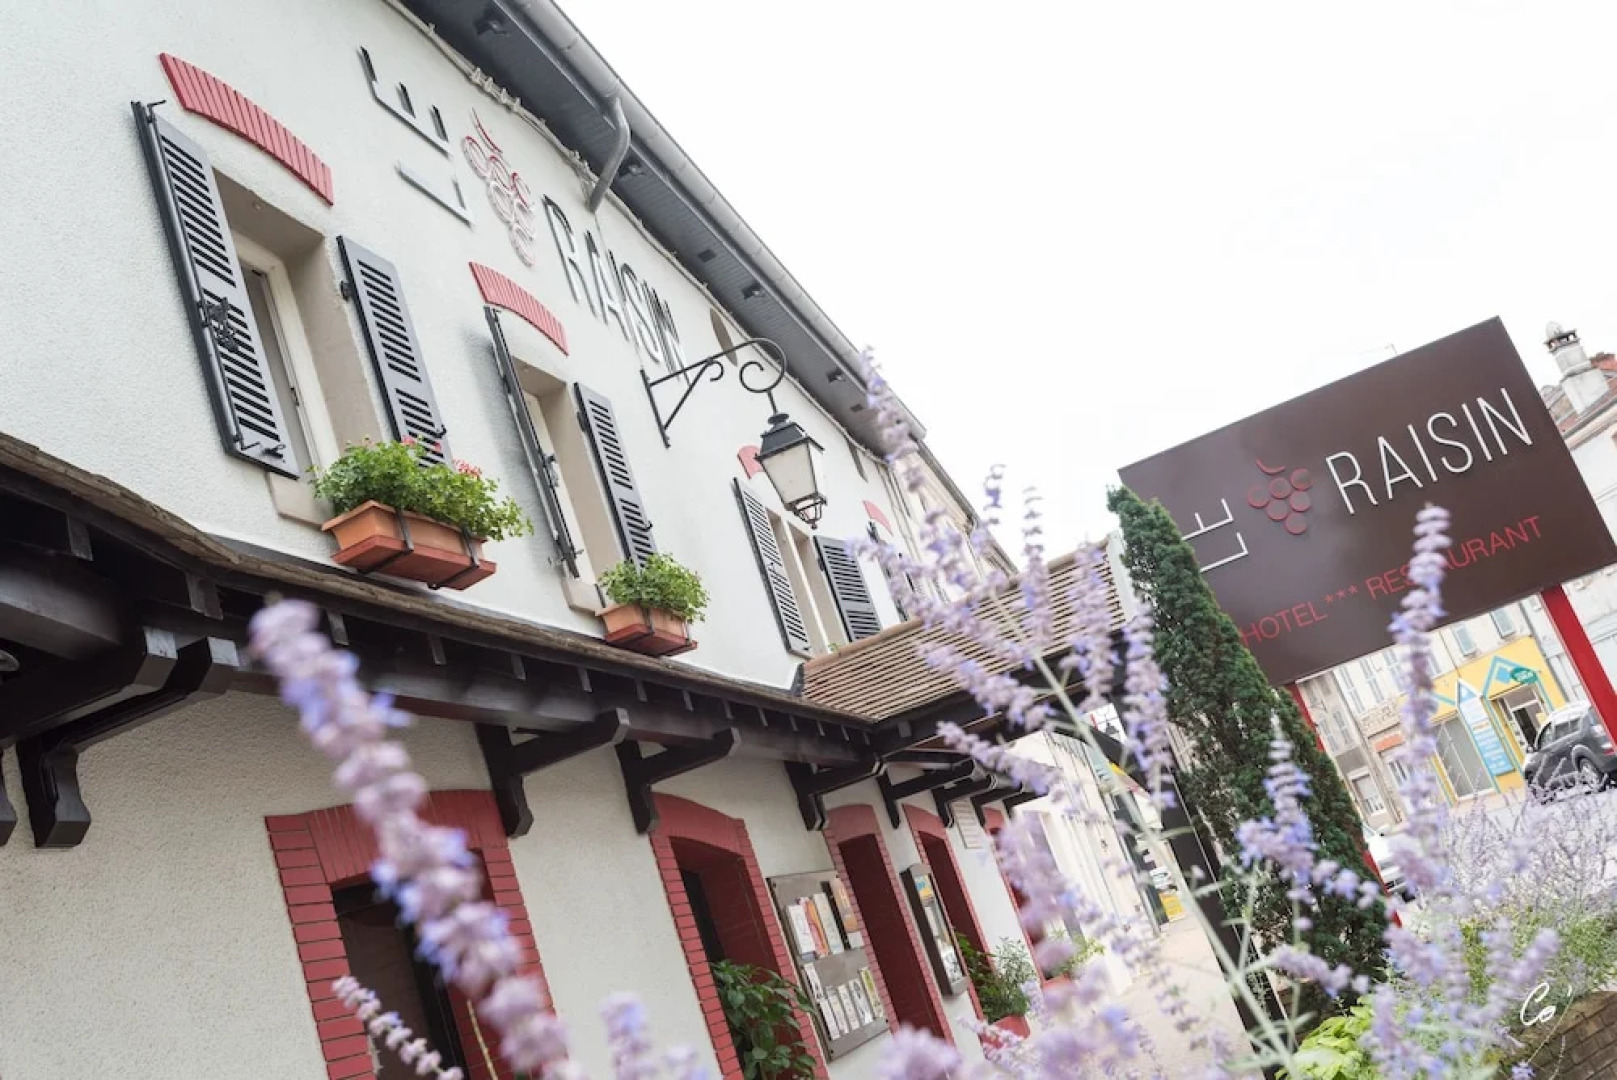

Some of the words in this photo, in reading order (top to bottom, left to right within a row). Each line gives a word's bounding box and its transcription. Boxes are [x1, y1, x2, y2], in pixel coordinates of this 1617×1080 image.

[541, 194, 691, 386] RAISIN
[1325, 387, 1533, 515] RAISIN
[1365, 515, 1542, 600] RESURANT
